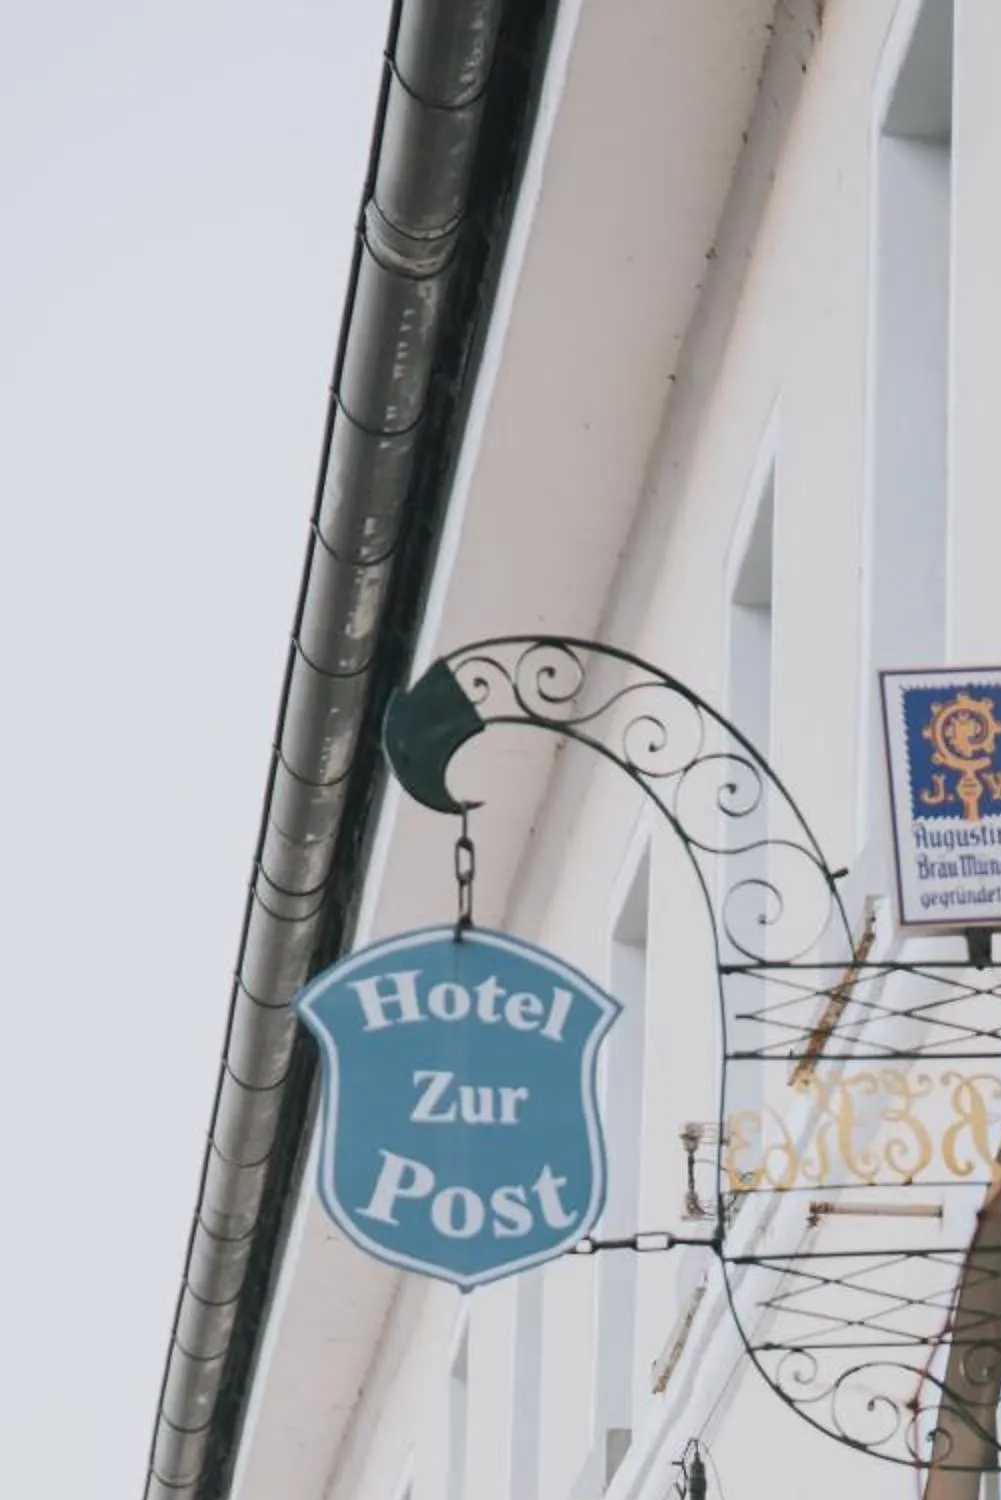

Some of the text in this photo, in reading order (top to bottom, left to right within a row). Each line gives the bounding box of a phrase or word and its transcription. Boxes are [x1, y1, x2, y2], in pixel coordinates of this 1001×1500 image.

[350, 968, 575, 1042] Hotel
[410, 1069, 529, 1125] Zur
[355, 1148, 579, 1239] Post
